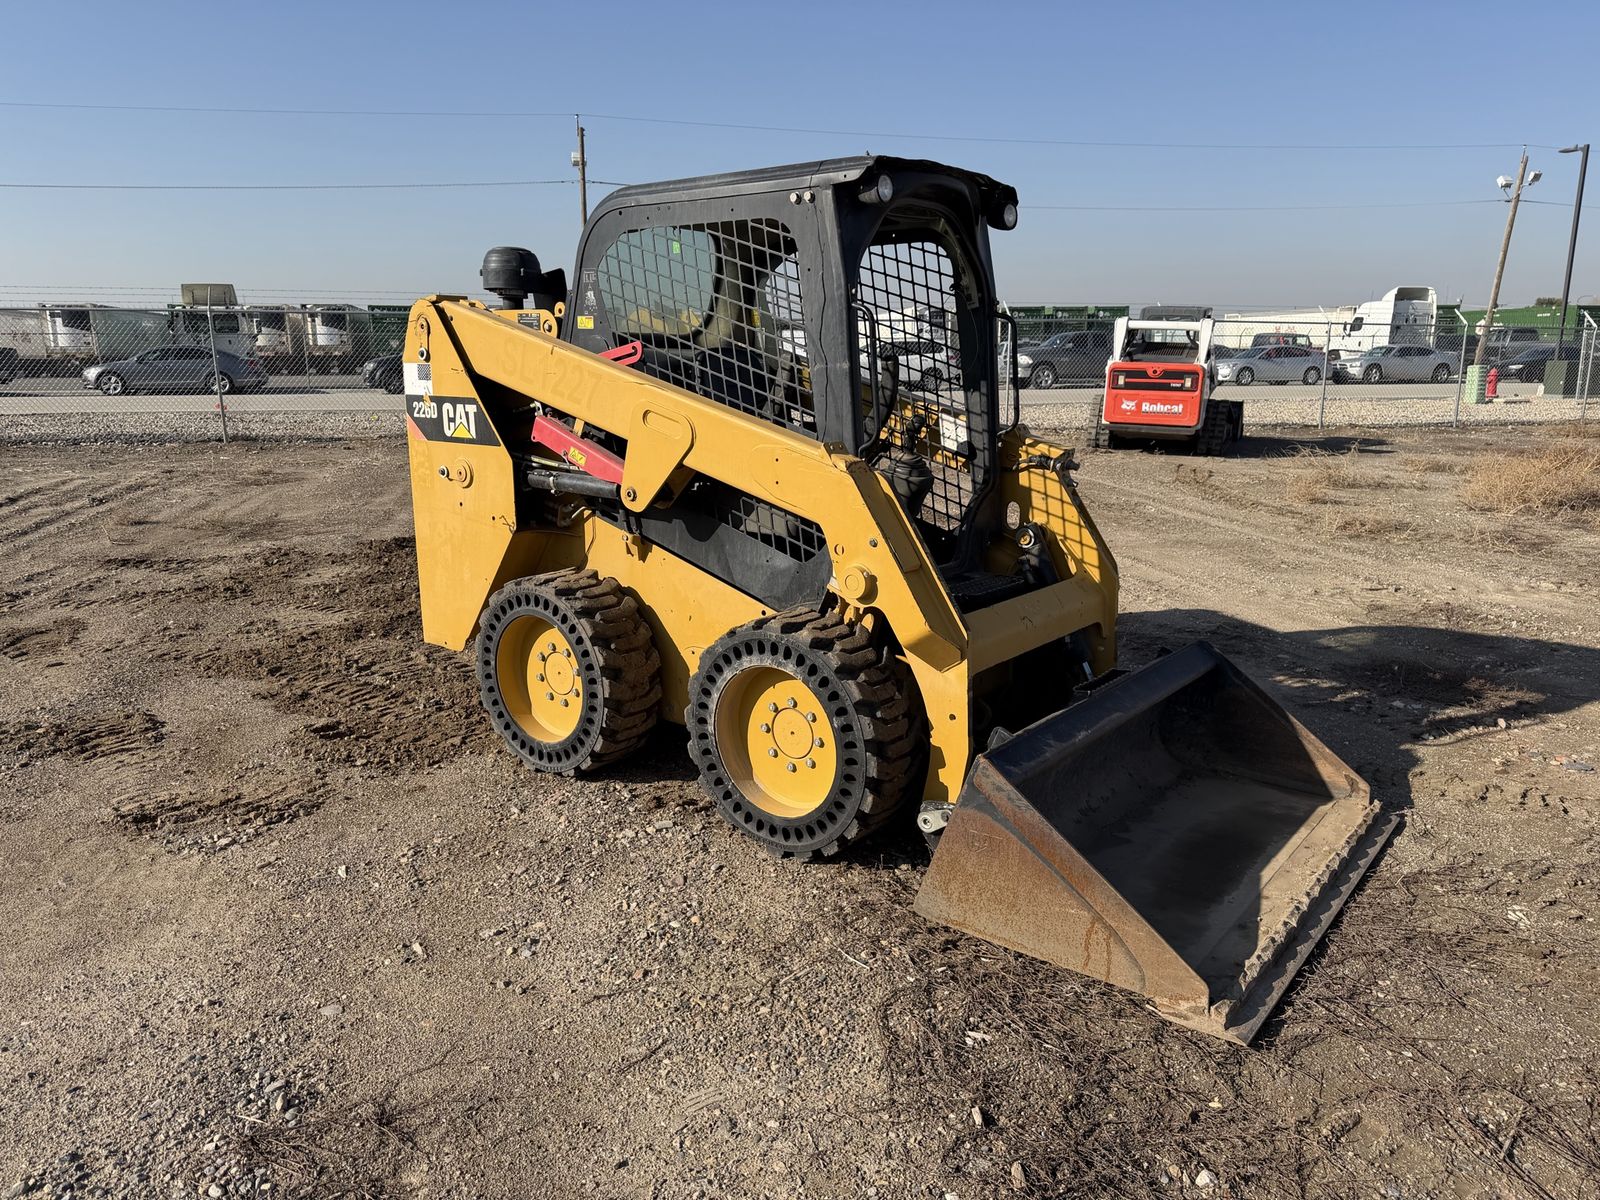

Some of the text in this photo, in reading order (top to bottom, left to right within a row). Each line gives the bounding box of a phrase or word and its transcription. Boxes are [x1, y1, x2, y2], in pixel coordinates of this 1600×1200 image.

[412, 401, 438, 419] 226D
[1142, 402, 1183, 413] Bobcat
[442, 402, 477, 439] CAT
